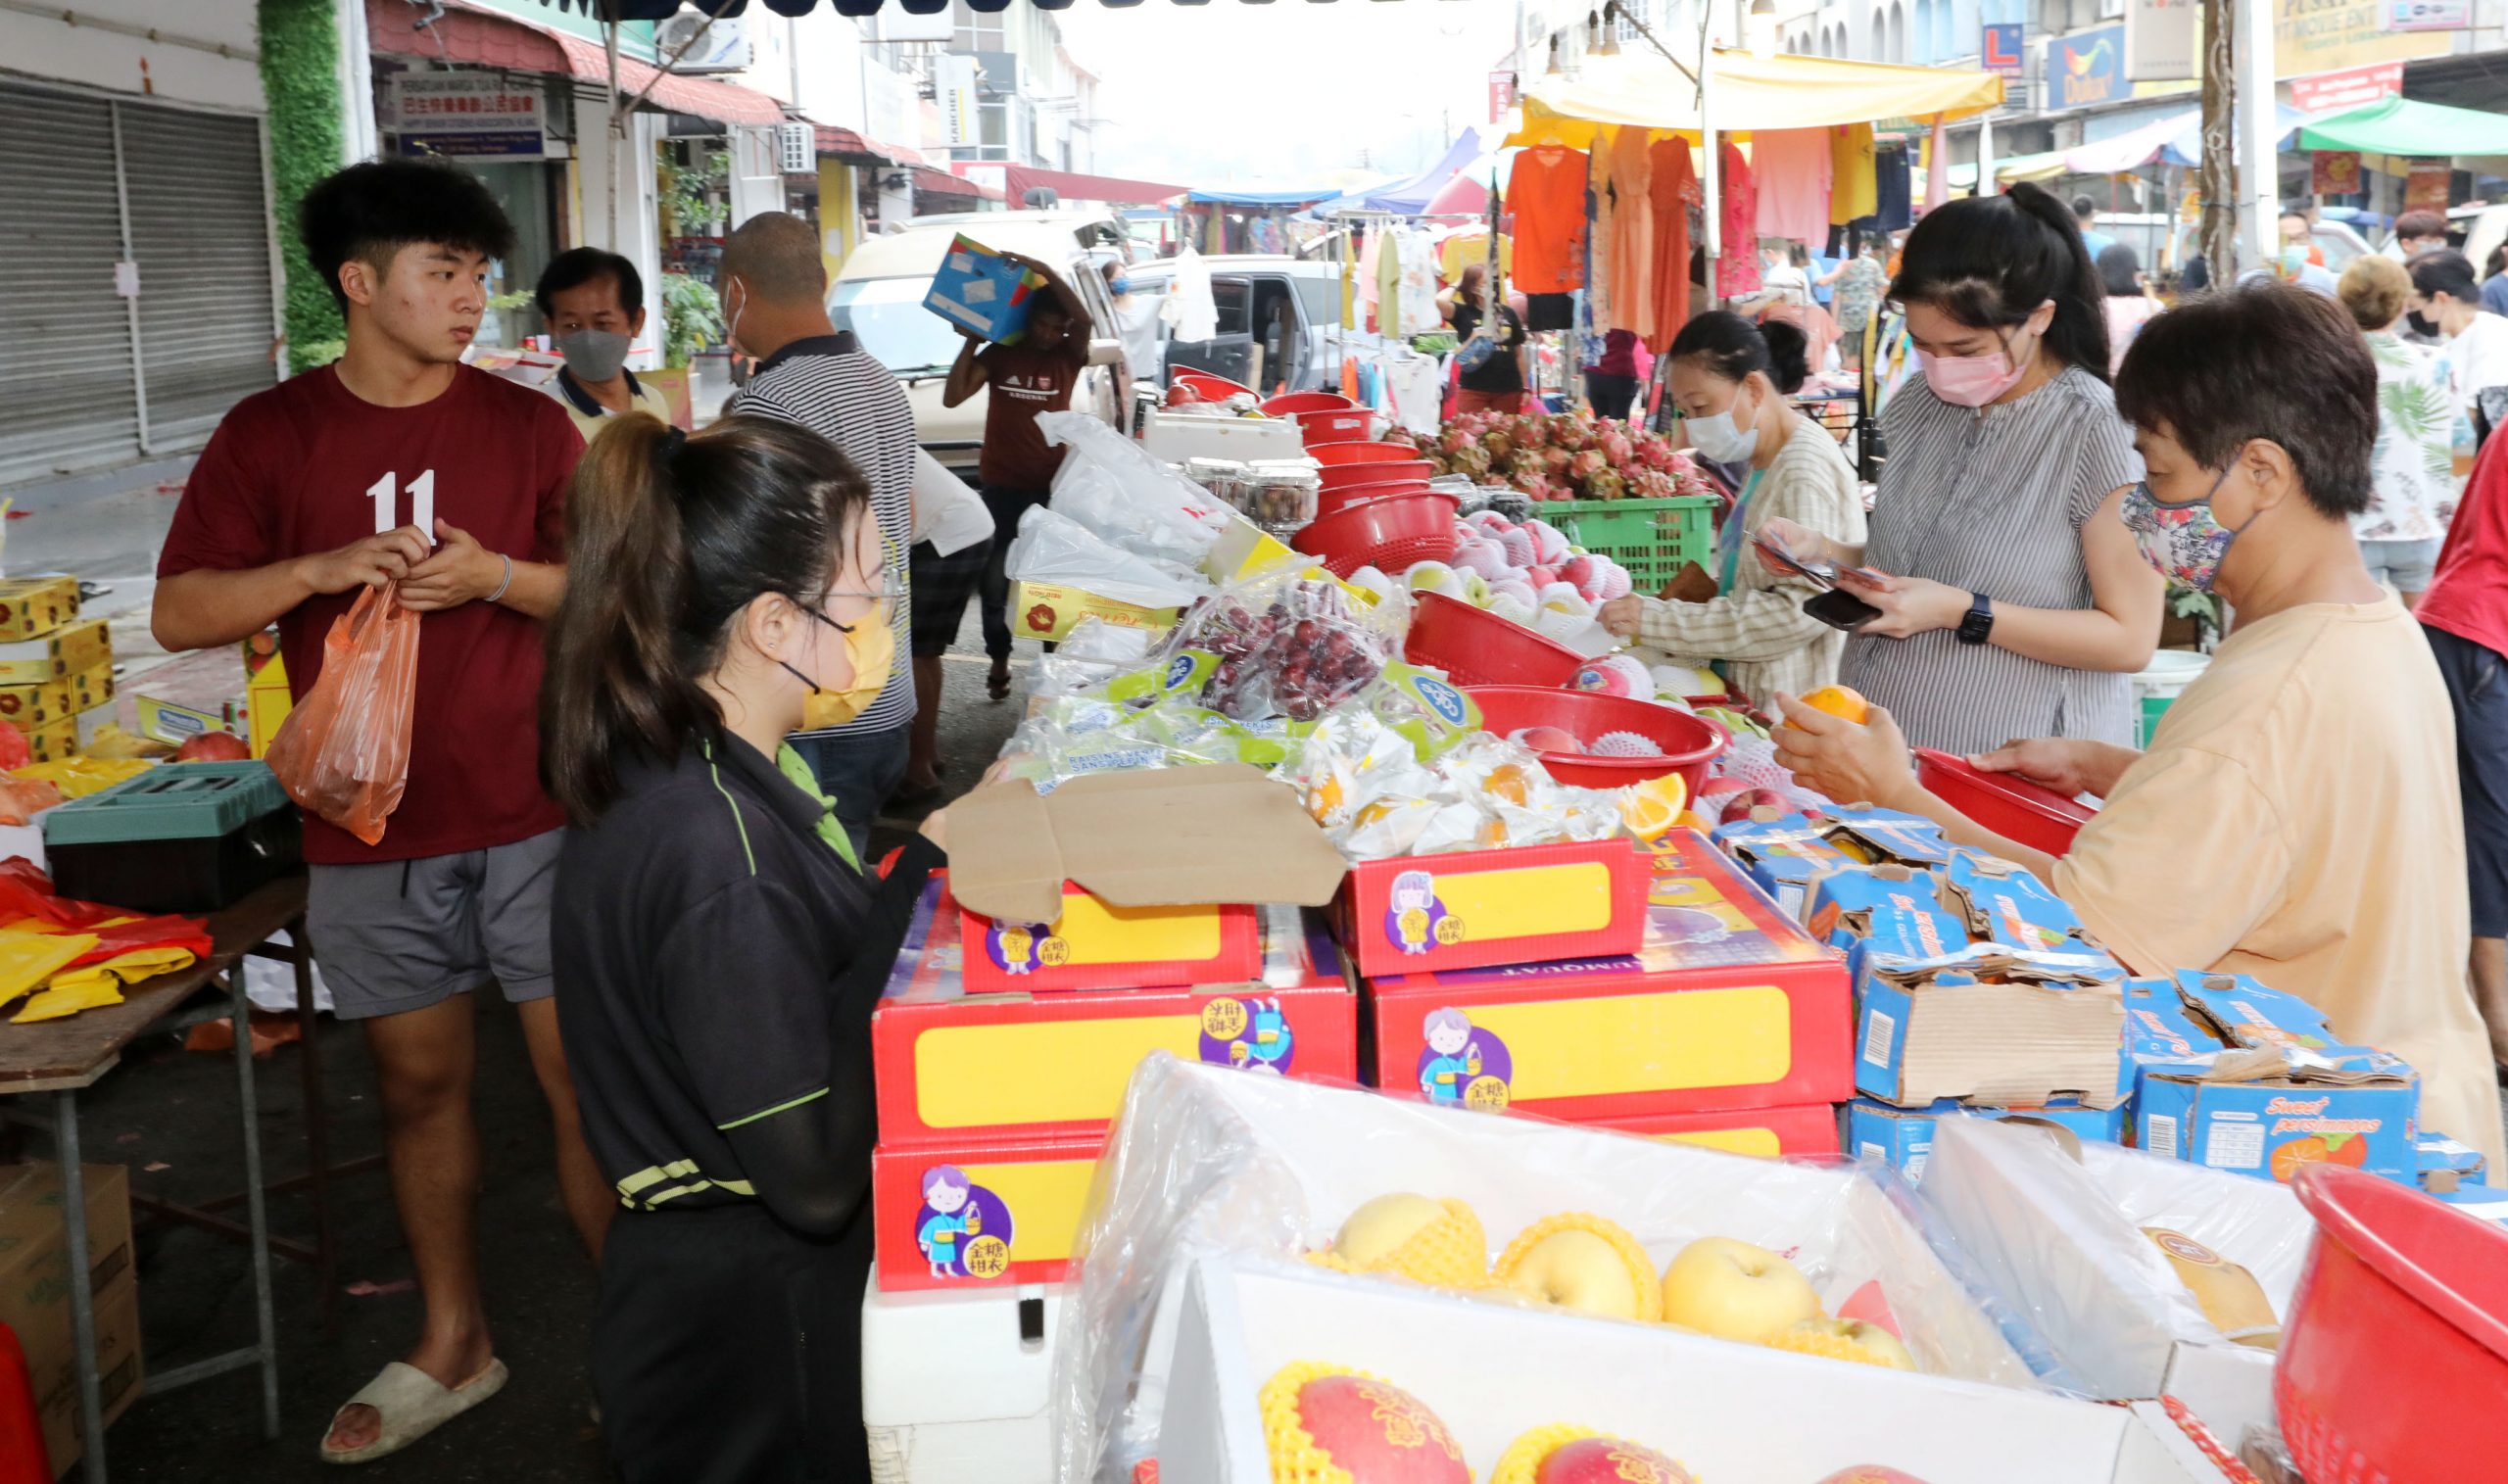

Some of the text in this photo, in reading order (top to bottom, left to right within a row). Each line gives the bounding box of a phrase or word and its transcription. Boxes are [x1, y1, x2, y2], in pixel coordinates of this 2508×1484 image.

[1987, 29, 2018, 64] L
[1008, 392, 1048, 402] ARSENAL
[366, 469, 437, 547] 11
[2265, 1096, 2330, 1115] Sweet
[2271, 1116, 2383, 1135] persimmons
